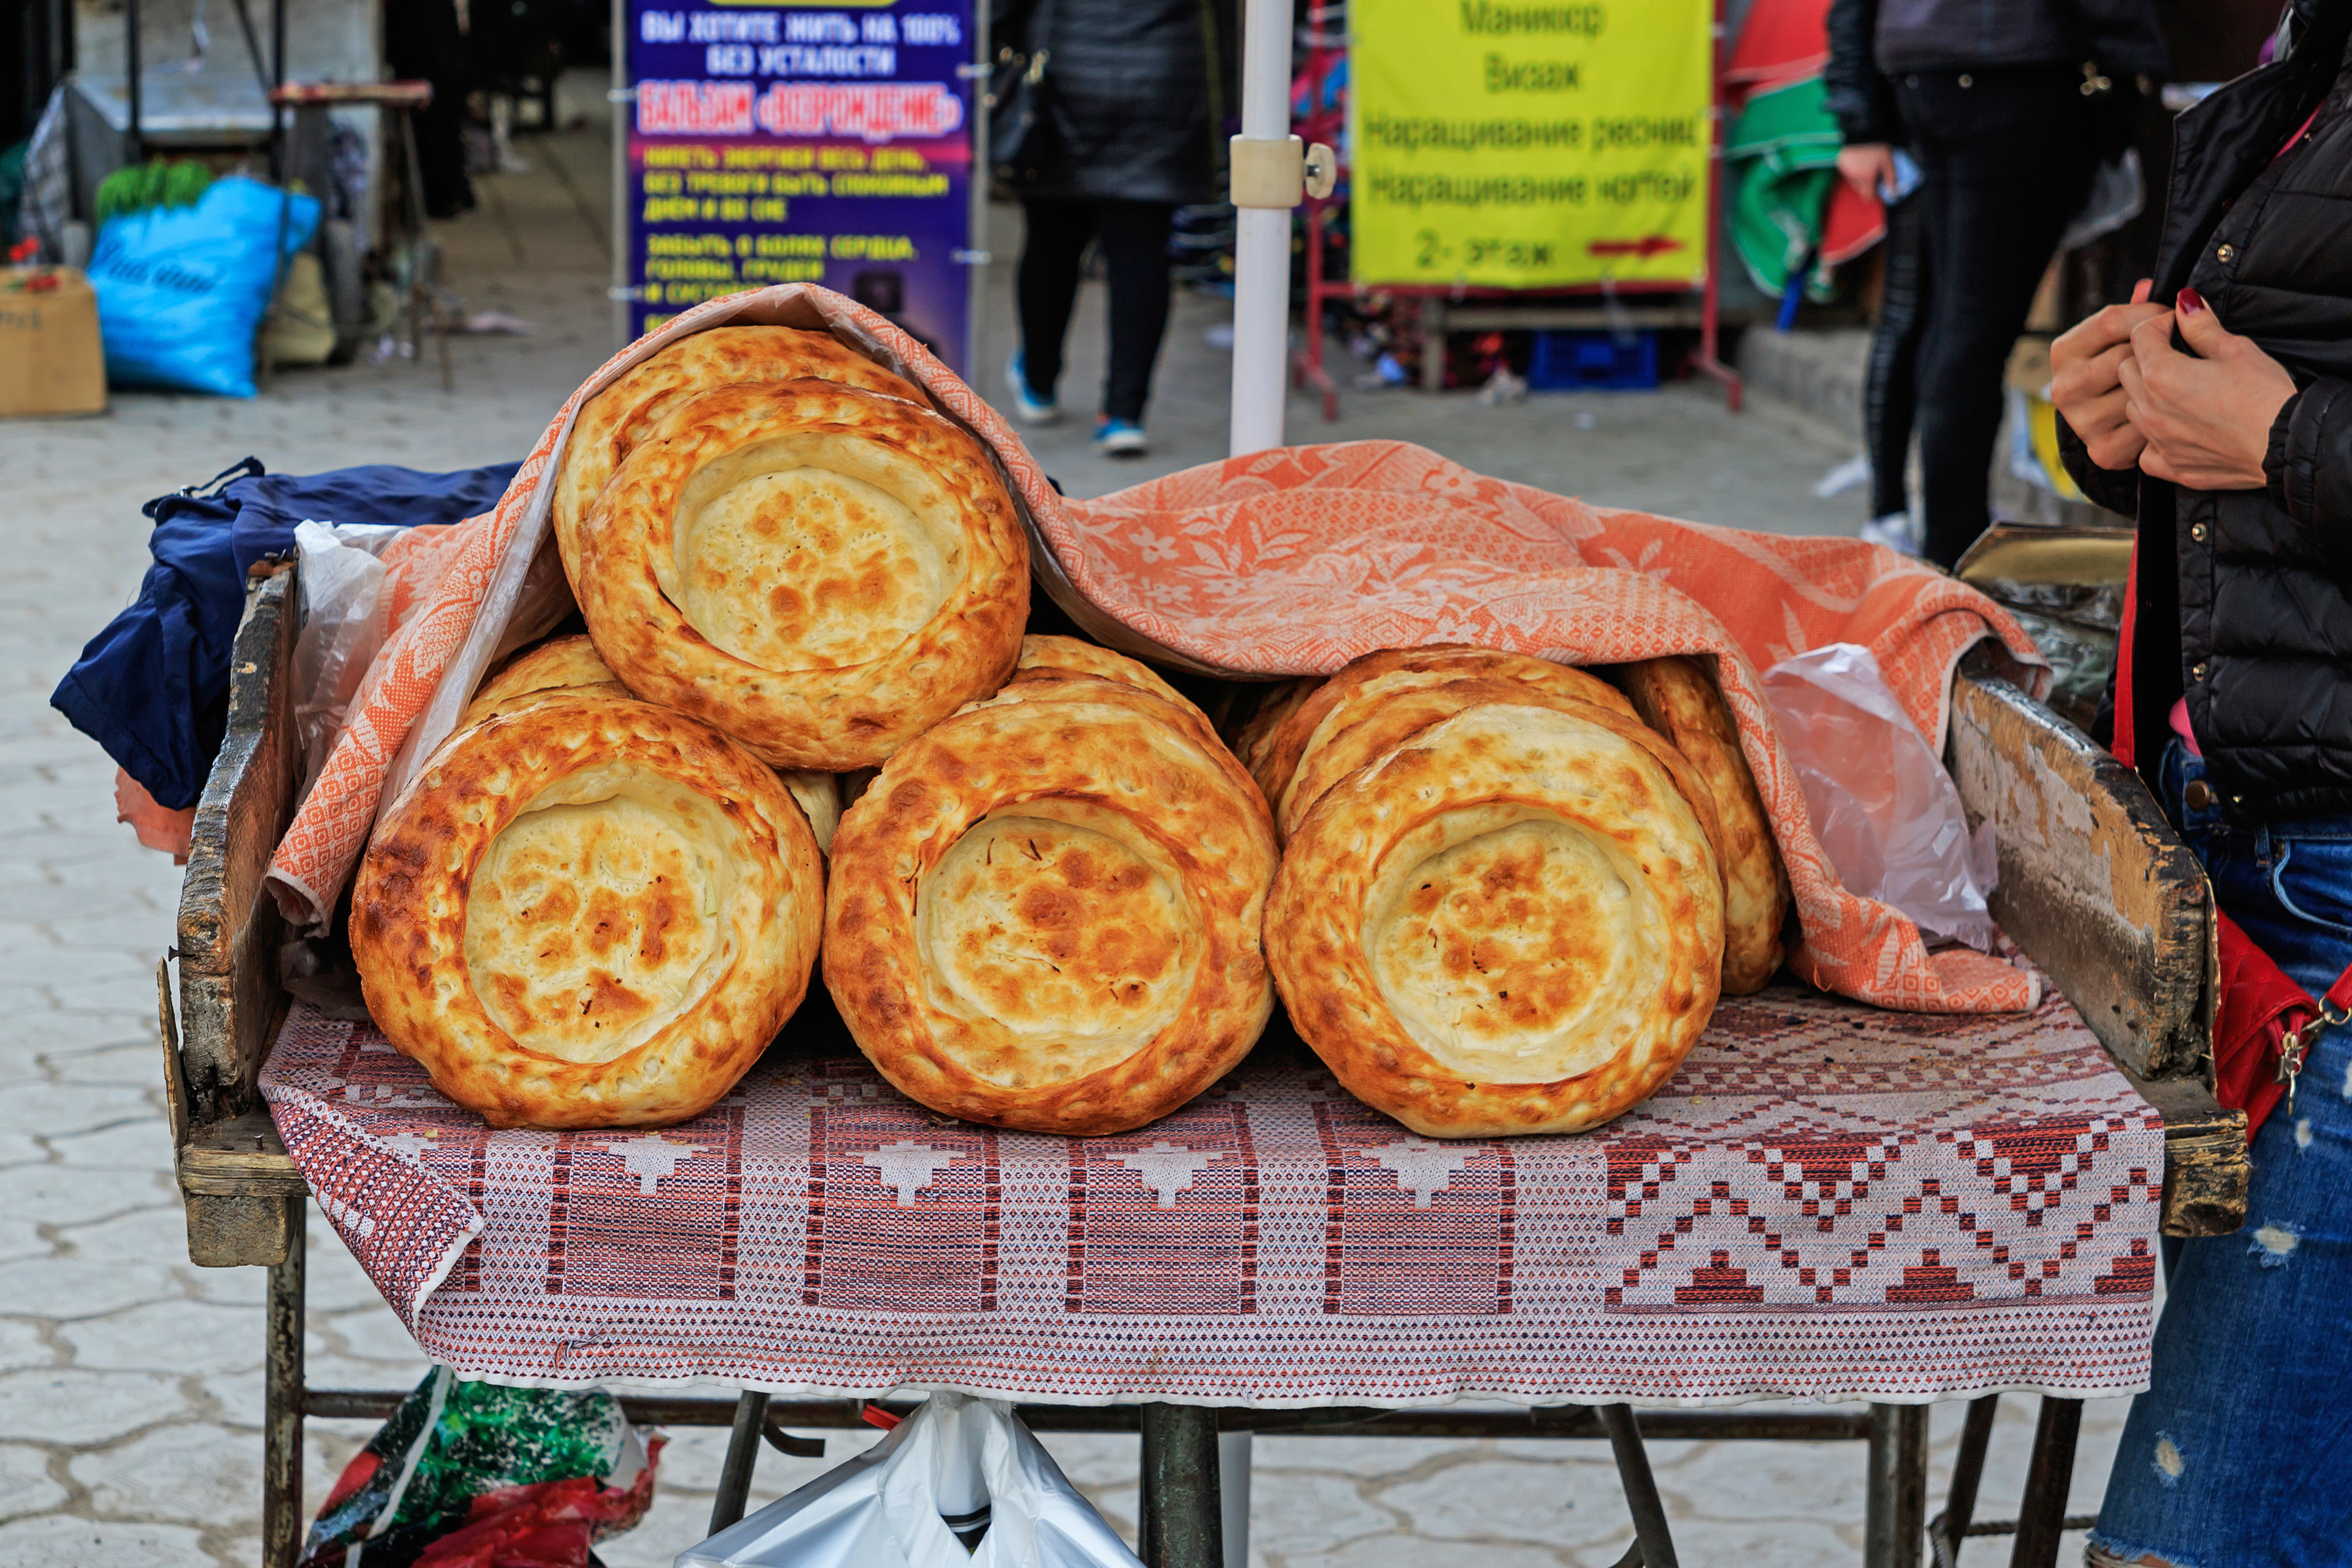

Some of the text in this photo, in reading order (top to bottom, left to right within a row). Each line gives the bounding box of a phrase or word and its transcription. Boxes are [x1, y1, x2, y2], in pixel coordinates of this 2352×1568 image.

[642, 12, 684, 41] ВЫ
[863, 14, 897, 42] НА
[707, 45, 754, 75] БЕЗ
[1484, 53, 1581, 92] Визаж
[1364, 110, 1582, 155] Наращивание
[1369, 168, 1584, 211] Наращивание
[1465, 238, 1554, 267] этаж
